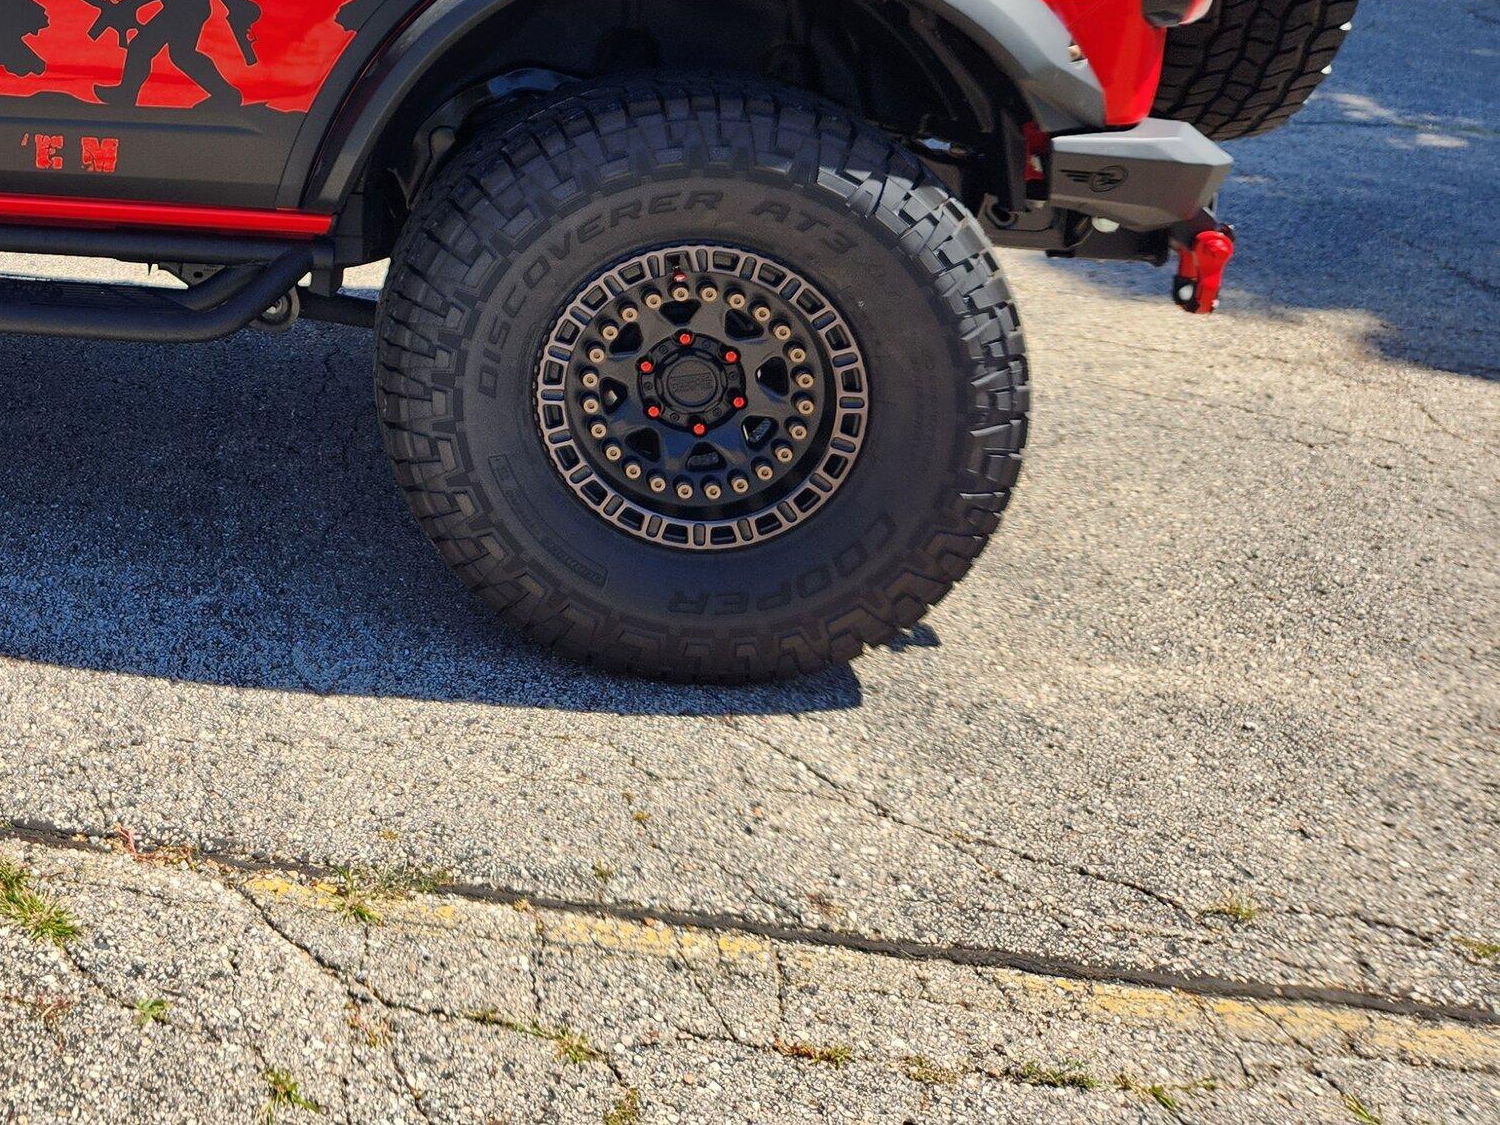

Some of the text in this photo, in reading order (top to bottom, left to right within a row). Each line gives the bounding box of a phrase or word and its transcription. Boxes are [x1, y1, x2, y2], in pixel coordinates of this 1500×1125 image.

[477, 189, 859, 399] DISCOVERER AT3
[667, 512, 898, 615] COOPER
